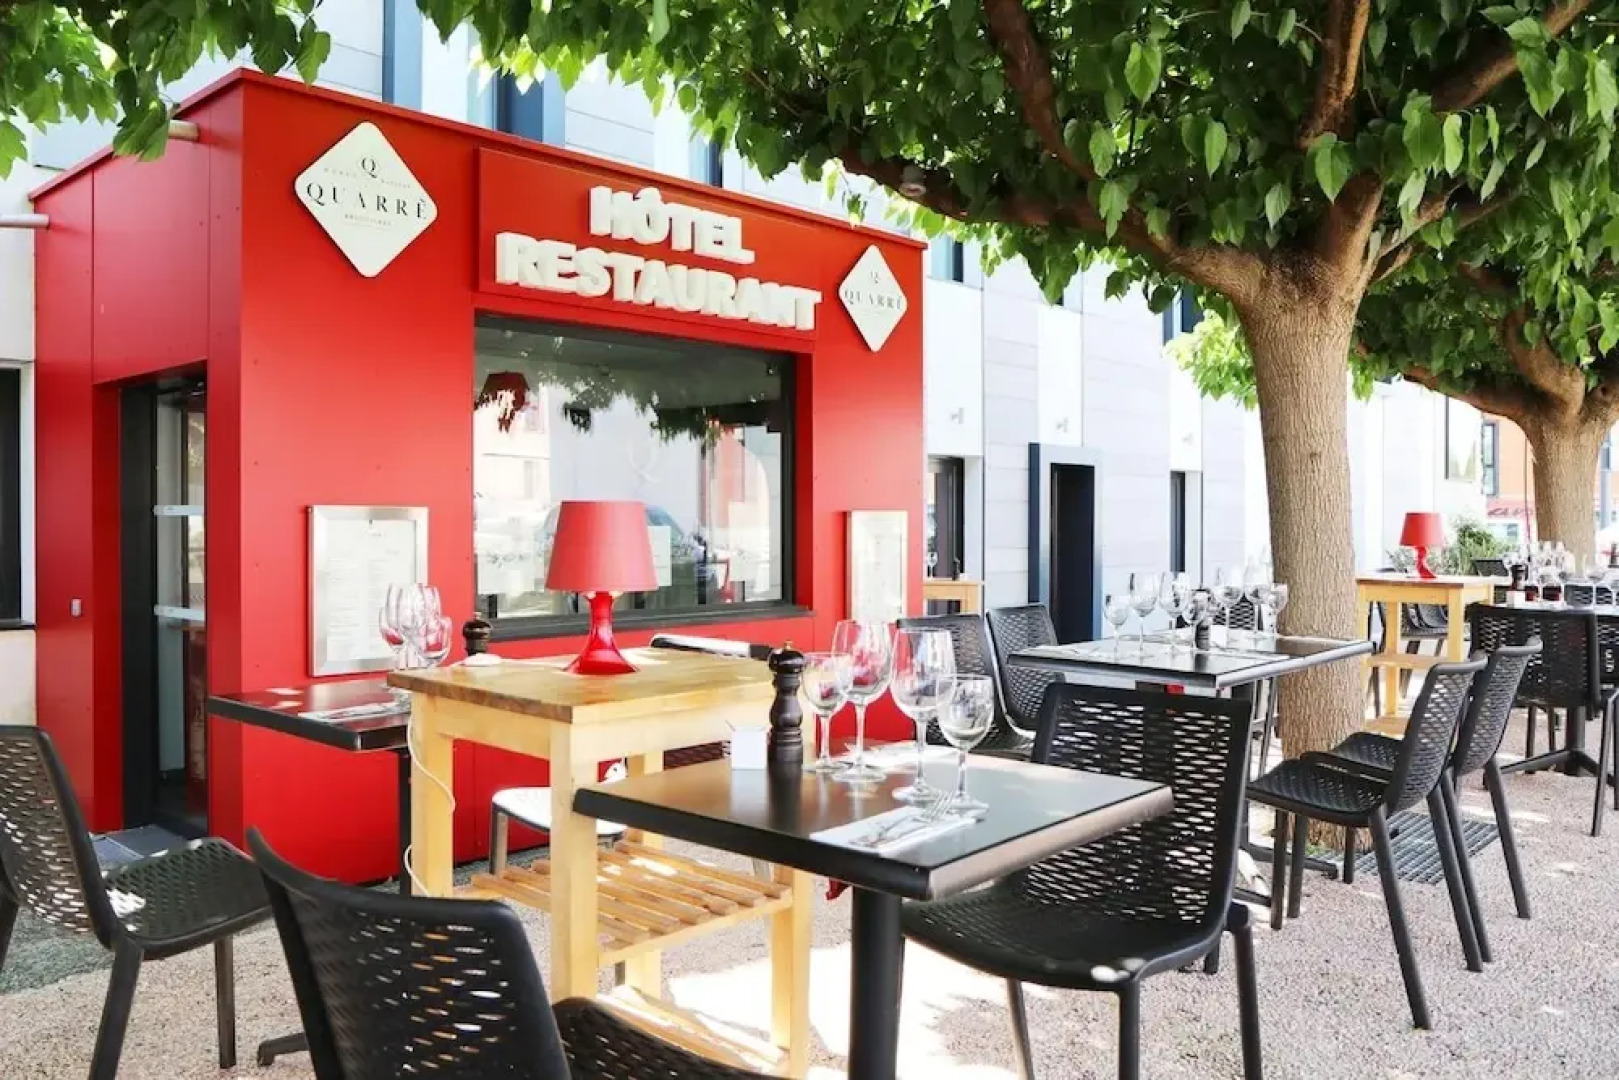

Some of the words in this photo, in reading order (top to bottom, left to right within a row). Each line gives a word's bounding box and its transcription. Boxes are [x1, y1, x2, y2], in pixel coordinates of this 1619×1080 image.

[361, 156, 379, 179] Q
[588, 185, 755, 265] HÔTEL
[495, 231, 823, 331] RESTAURANT
